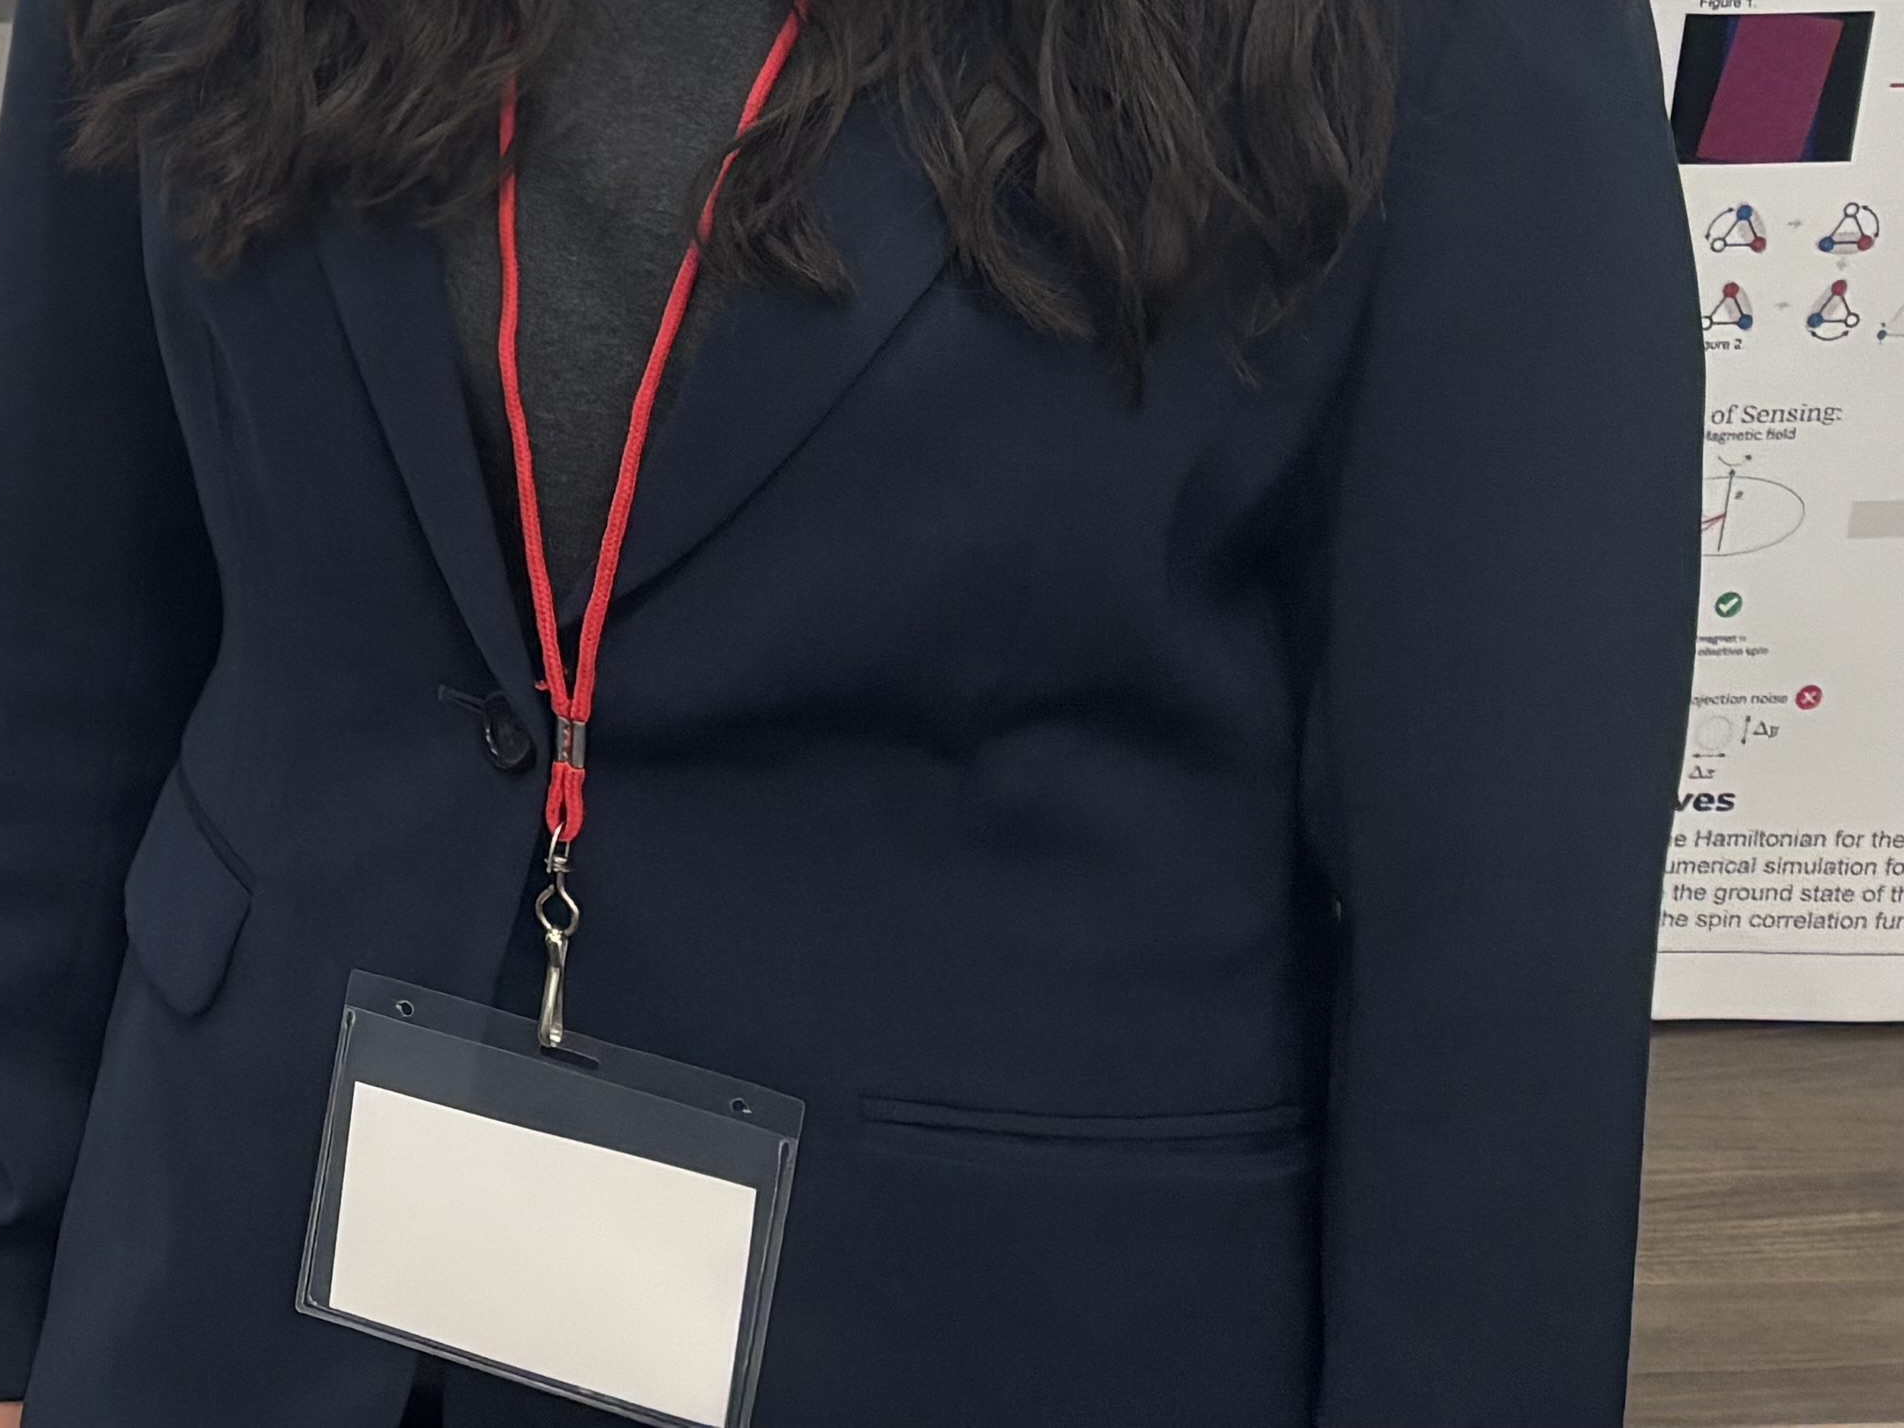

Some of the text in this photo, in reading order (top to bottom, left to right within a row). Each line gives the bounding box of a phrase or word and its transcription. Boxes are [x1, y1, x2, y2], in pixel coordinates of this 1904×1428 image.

[1711, 404, 1843, 426] of Sensing:
[1694, 830, 1827, 848] Hamiltonian
[1836, 830, 1865, 848] for
[1763, 857, 1878, 876] simulation
[1673, 884, 1886, 905] the ground state of
[1695, 911, 1868, 931] spin correlation
